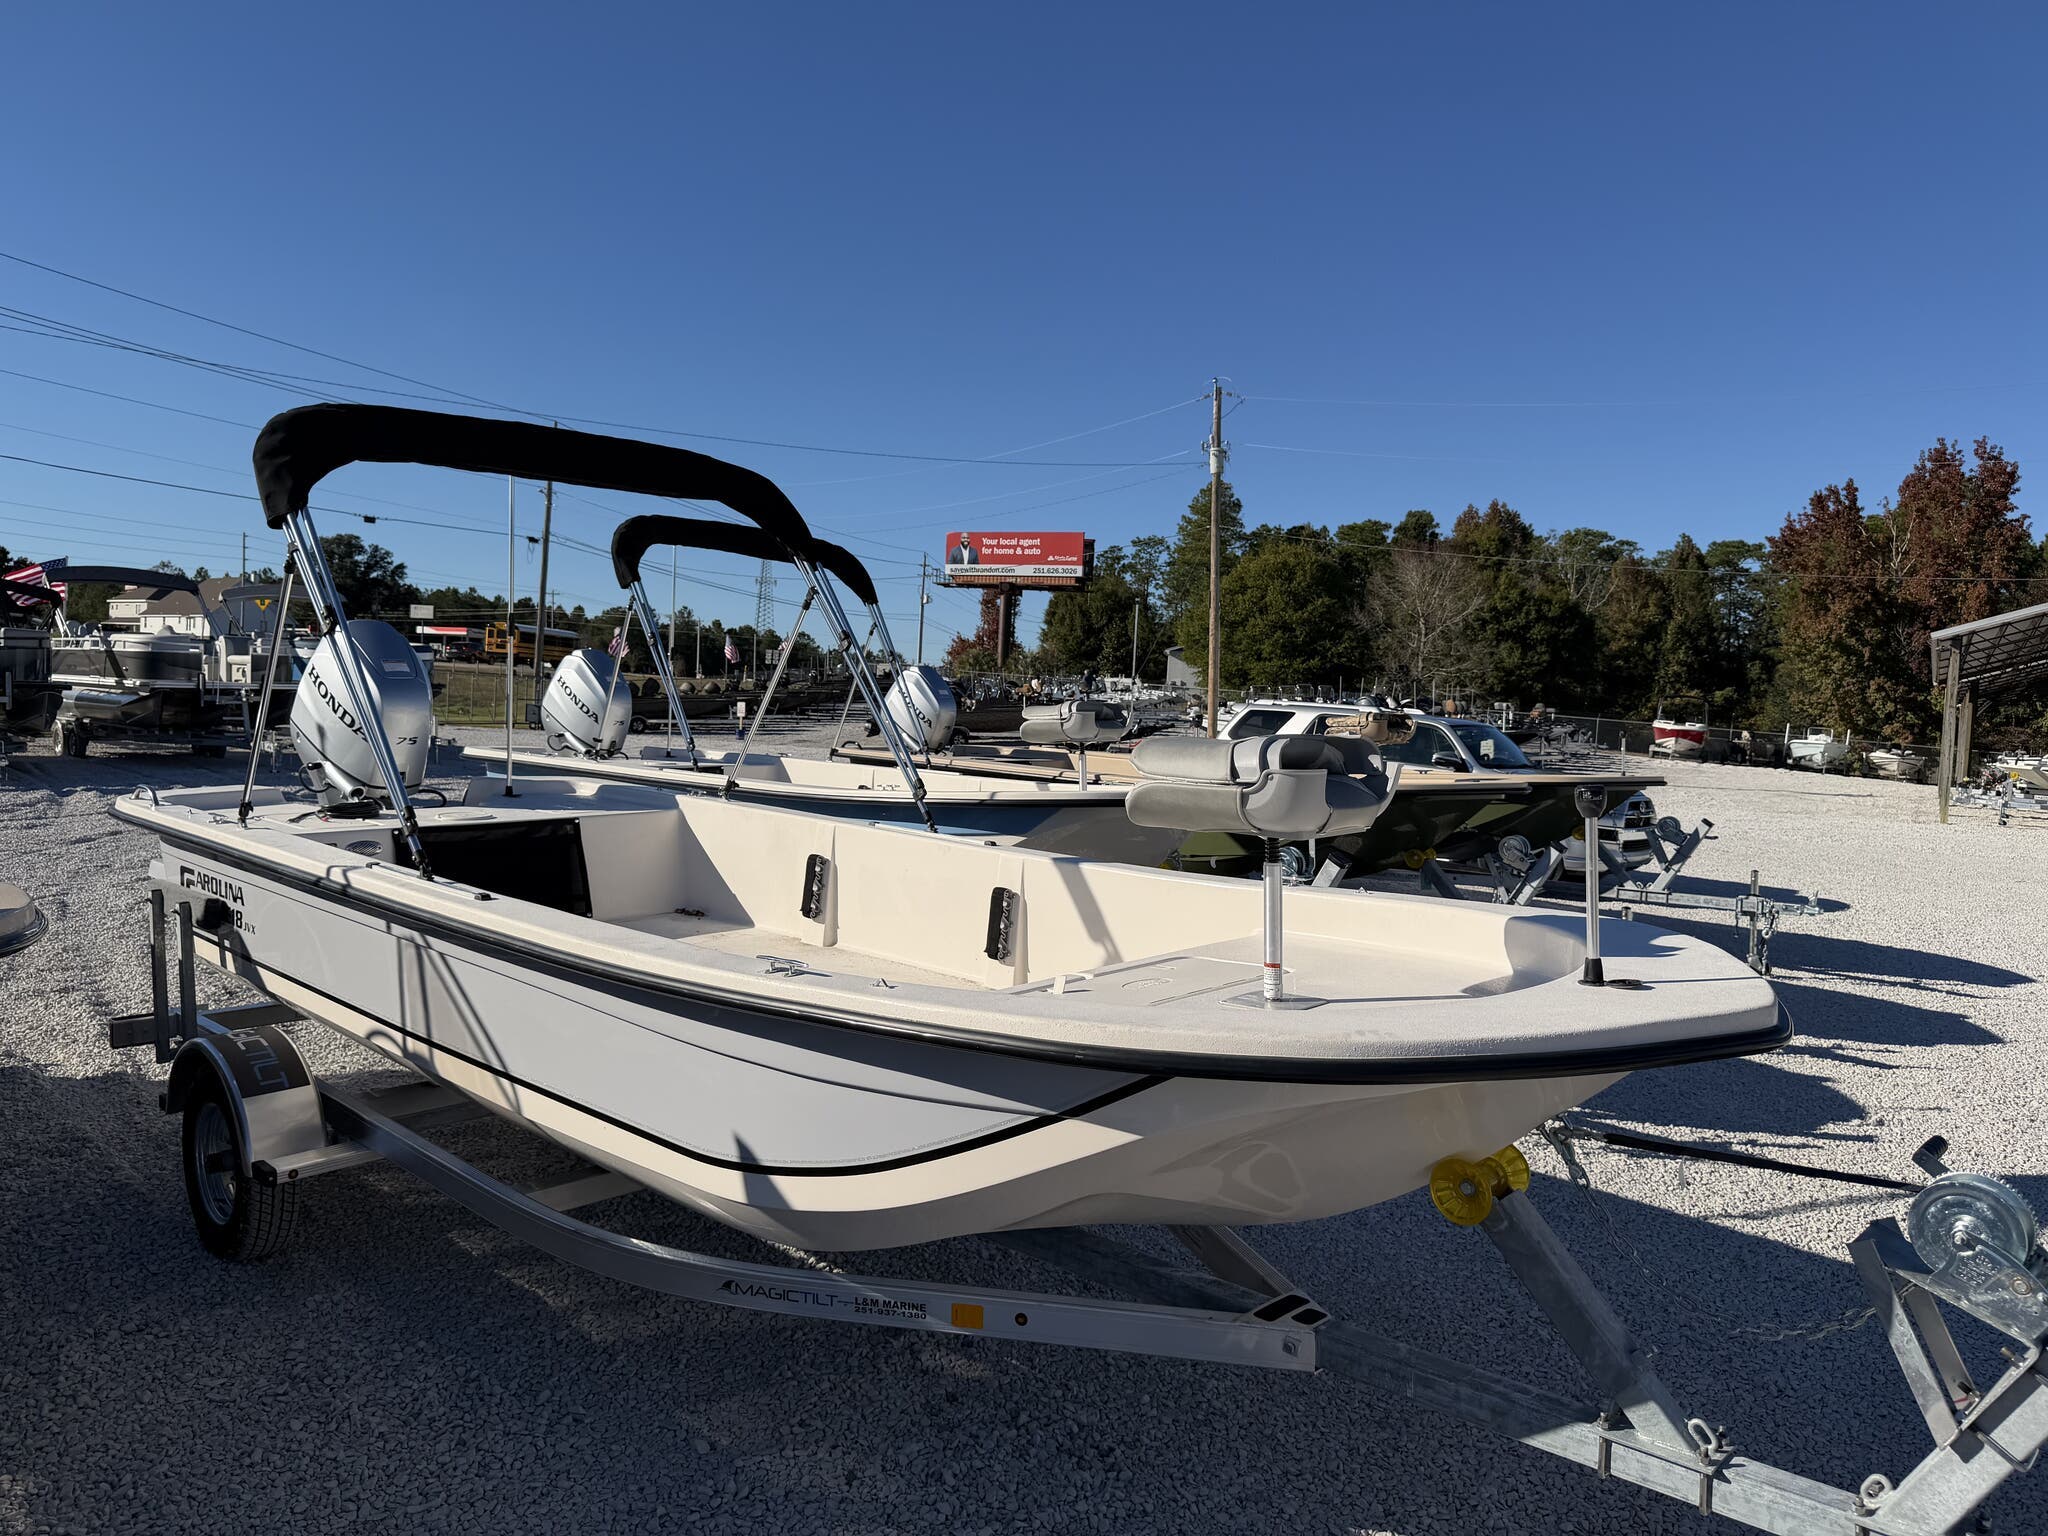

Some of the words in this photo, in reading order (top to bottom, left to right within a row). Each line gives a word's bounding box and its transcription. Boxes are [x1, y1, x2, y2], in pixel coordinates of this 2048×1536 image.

[982, 538, 998, 546] Your
[999, 538, 1017, 546] local
[1019, 538, 1040, 547] agent
[982, 547, 992, 555] for
[993, 547, 1014, 555] home
[557, 675, 599, 725] HONDA
[396, 736, 419, 746] 75
[734, 1282, 839, 1307] MAGICTILT
[854, 1297, 879, 1308] L&M
[883, 1300, 927, 1313] MARINE
[854, 1306, 927, 1320] 251-937-1380
